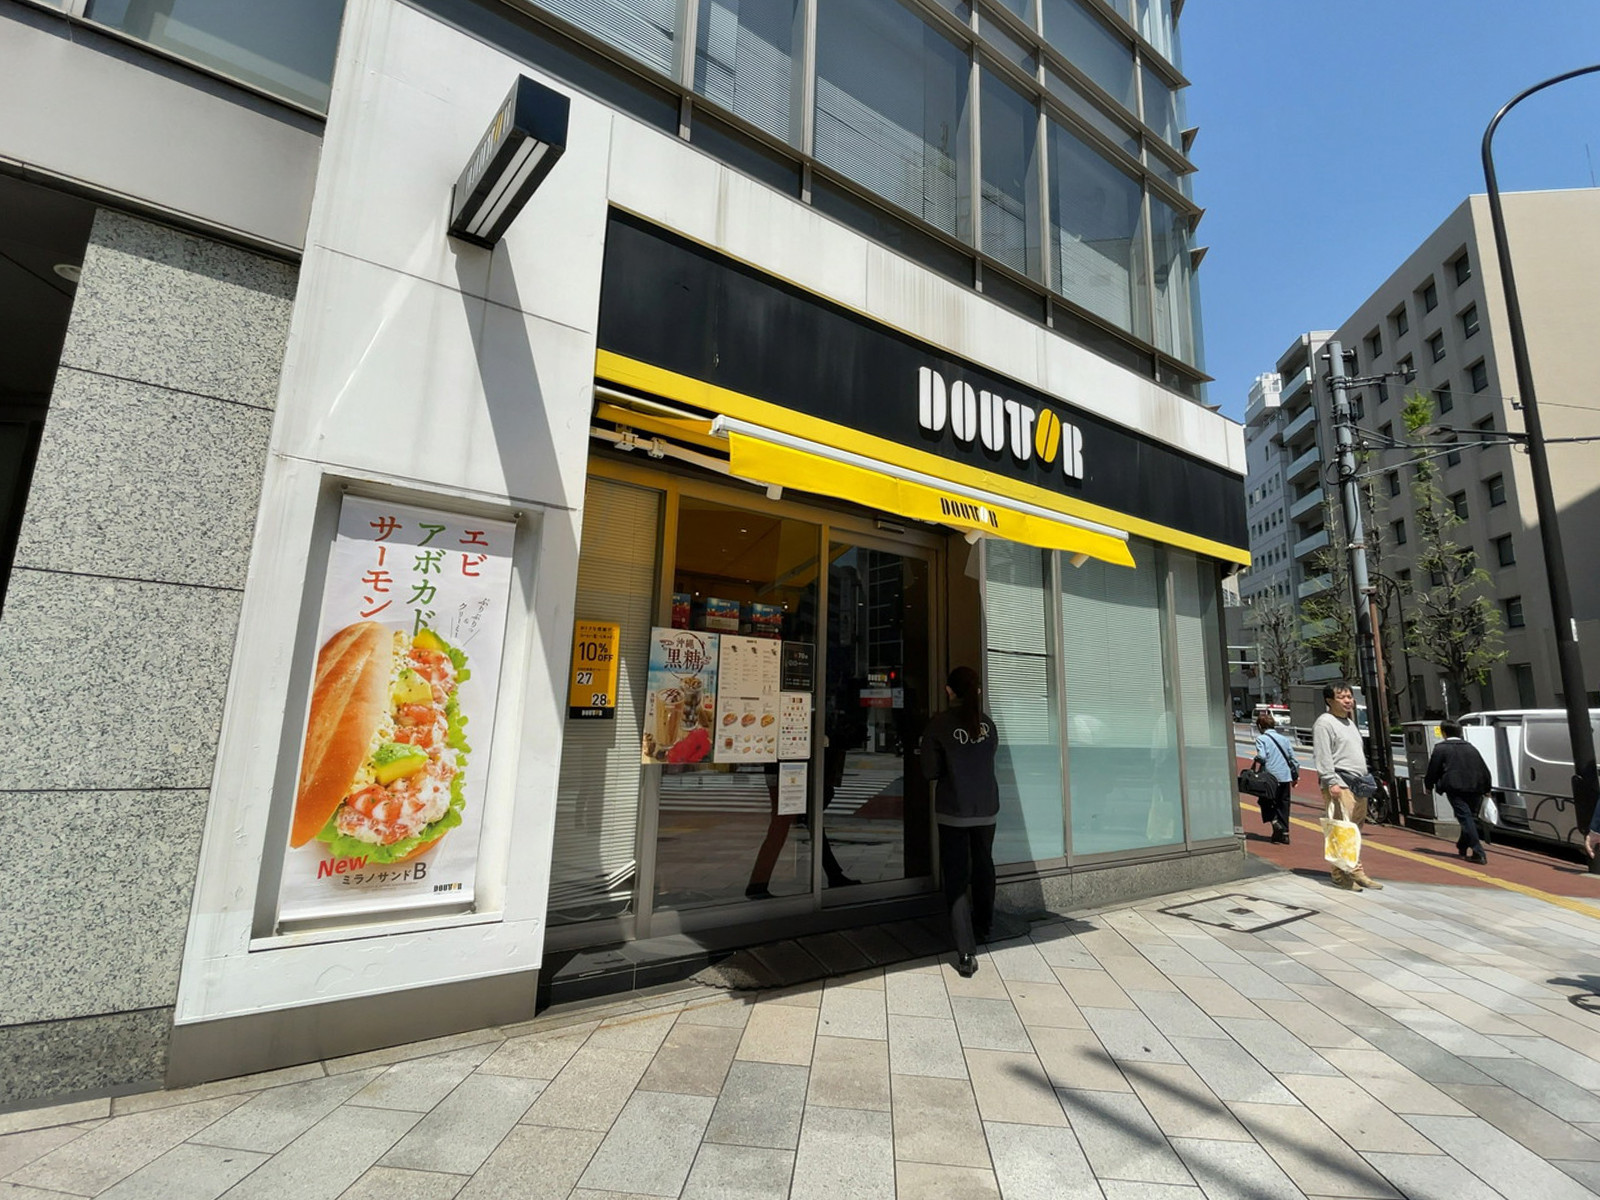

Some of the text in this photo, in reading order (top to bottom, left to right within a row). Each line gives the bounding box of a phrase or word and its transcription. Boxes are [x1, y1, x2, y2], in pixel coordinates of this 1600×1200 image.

[918, 366, 1084, 480] DOUTOR
[940, 497, 998, 528] DOUTOR
[359, 516, 403, 618] サーモン
[459, 530, 489, 577] エビ
[406, 522, 446, 637] アボカド
[597, 654, 614, 662] OFF
[664, 647, 701, 670] 黒糖
[577, 672, 592, 684] 27
[317, 855, 368, 879] New
